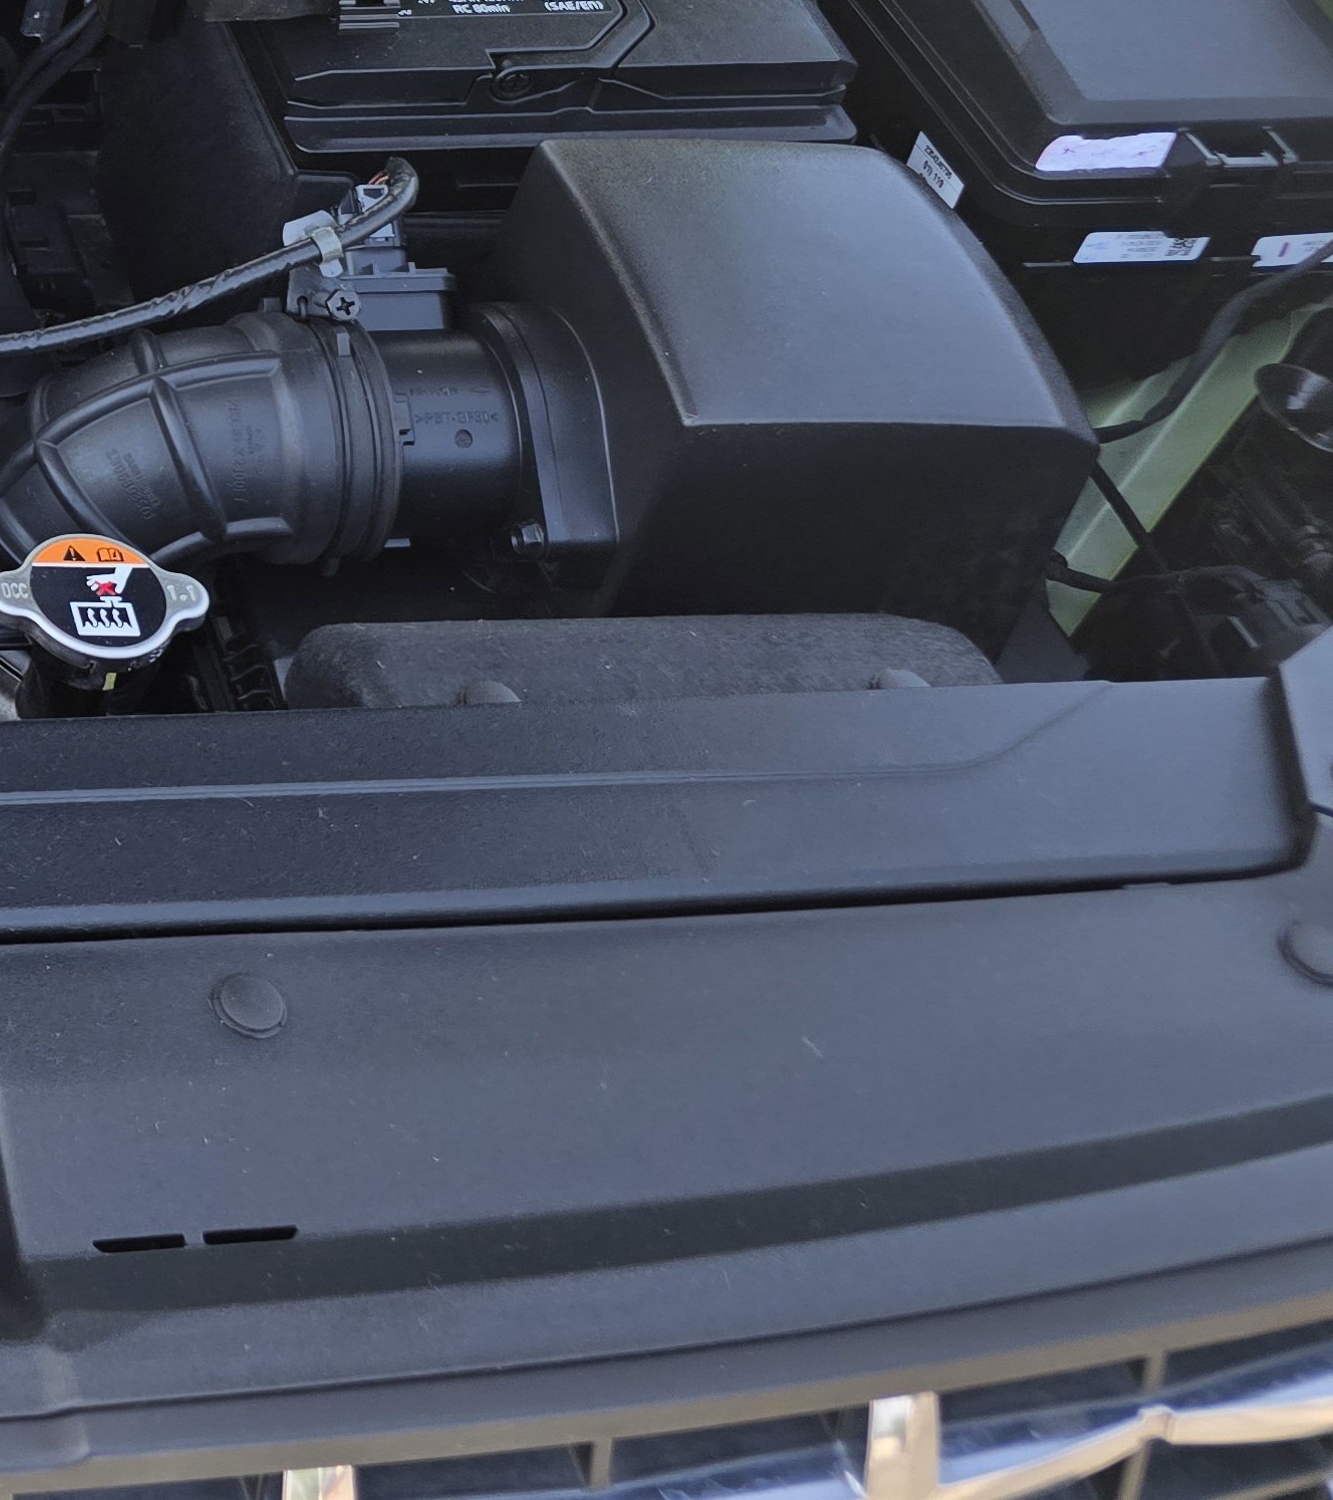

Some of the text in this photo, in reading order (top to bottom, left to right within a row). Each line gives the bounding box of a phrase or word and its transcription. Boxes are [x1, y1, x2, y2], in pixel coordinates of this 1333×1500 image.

[452, 3, 472, 14] RC
[1, 582, 197, 601] DCC 1.1
